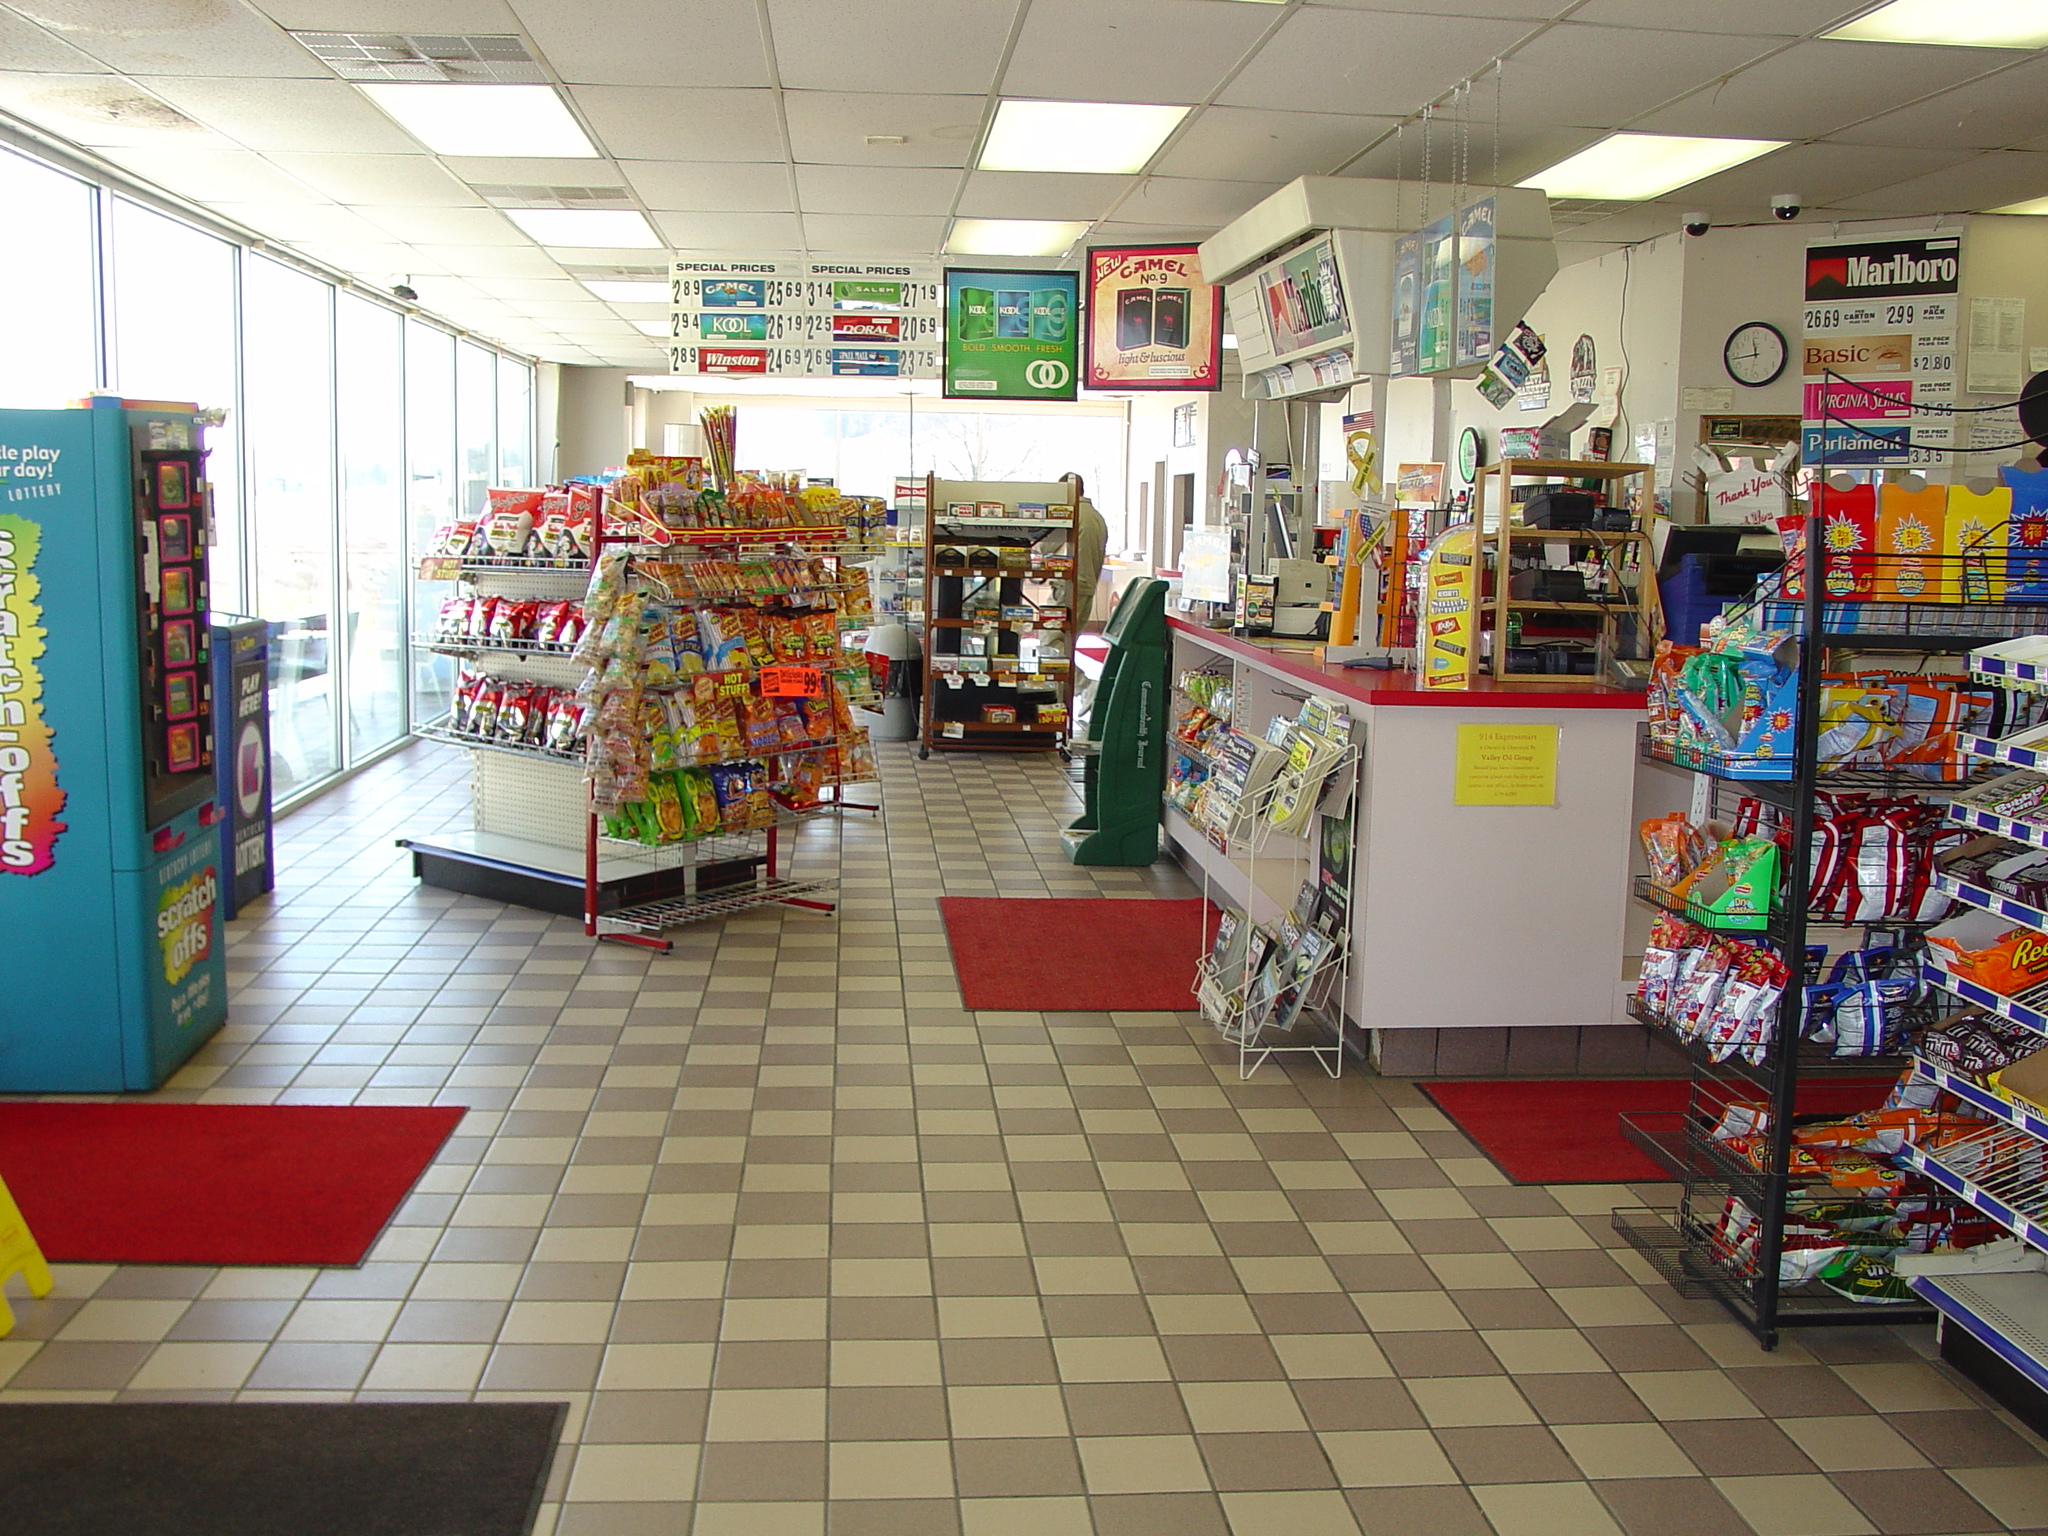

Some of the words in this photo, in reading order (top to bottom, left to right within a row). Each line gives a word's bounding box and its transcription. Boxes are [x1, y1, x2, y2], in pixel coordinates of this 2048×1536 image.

[1461, 207, 1493, 236] CAMEL
[676, 263, 727, 272] SPECIAL
[730, 264, 776, 273] PRICES
[811, 265, 863, 274] SPECIAL
[866, 266, 911, 275] PRICES
[1095, 255, 1122, 283] NEW
[1119, 258, 1188, 280] CAMEL
[1846, 254, 1957, 287] Marlboro
[705, 282, 757, 295] CAMEL
[1125, 295, 1152, 305] CAMEL
[1156, 295, 1183, 305] CAMEL
[969, 305, 987, 315] KOOL
[999, 306, 1021, 316] KOOL
[1034, 306, 1052, 316] KOOL
[713, 317, 752, 333] KOOL
[843, 325, 890, 335] DORAL
[962, 344, 986, 352] BOLD
[992, 344, 1030, 353] SMOOTH
[1036, 345, 1063, 353] FRESH
[1805, 345, 1870, 364] Basic
[706, 353, 760, 366] Winston
[1118, 351, 1138, 365] light
[1150, 351, 1186, 364] luscious
[1808, 433, 1902, 452] Parliament
[22, 445, 60, 463] play
[14, 462, 53, 480] day!
[8, 483, 62, 502] LOTTERY
[1716, 482, 1750, 505] Thank
[1750, 476, 1774, 497] You
[1430, 604, 1468, 615] Center
[1431, 598, 1468, 609] Snack
[242, 672, 260, 696] PLAY
[724, 673, 743, 684] HOT
[239, 692, 262, 718] HERE!
[1479, 733, 1493, 741] 914
[1481, 754, 1501, 763] Valley
[1514, 754, 1534, 763] Group
[1993, 785, 2046, 814] Bubble
[2000, 800, 2034, 817] Yum
[236, 832, 266, 877] LOTTERY
[157, 875, 217, 939] scratch
[1734, 898, 1748, 907] Dry
[172, 920, 207, 969] offs
